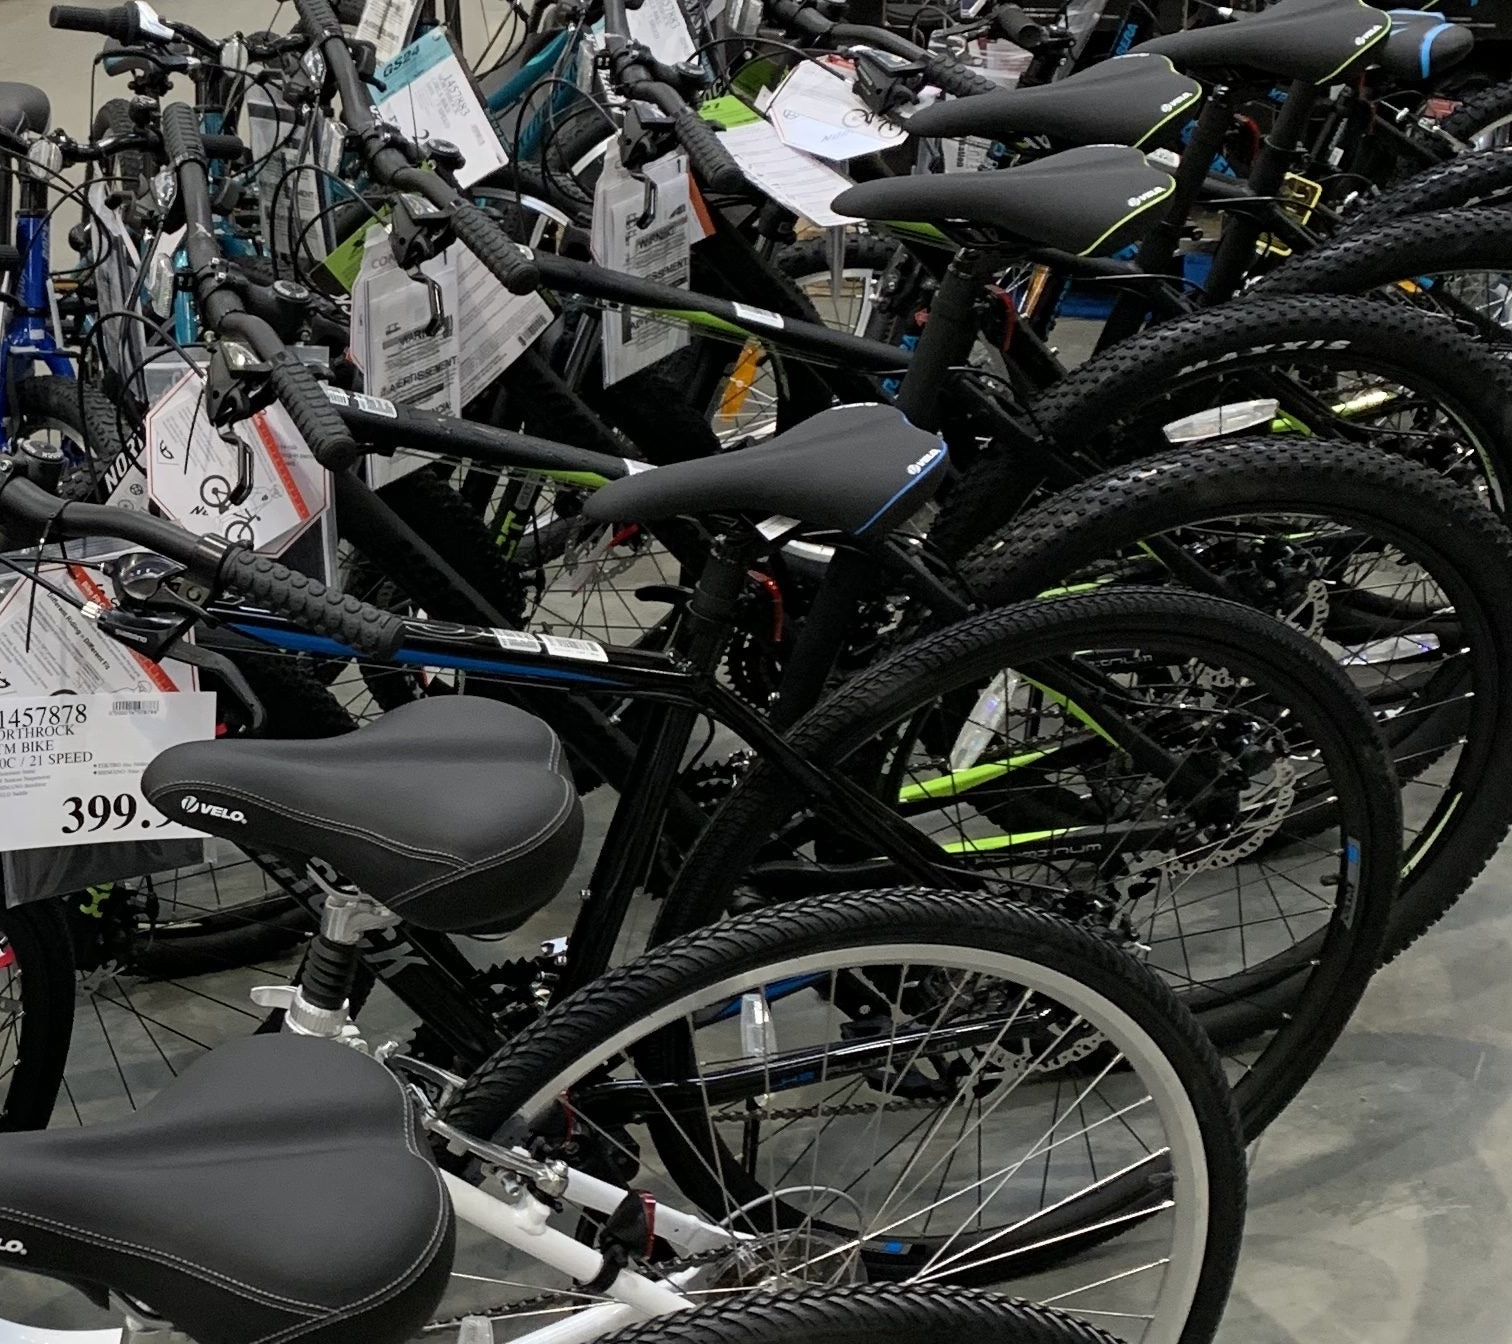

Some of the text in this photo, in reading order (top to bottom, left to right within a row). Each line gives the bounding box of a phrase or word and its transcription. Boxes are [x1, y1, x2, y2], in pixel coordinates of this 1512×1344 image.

[62, 613, 81, 635] Riding
[81, 636, 105, 663] Different
[21, 740, 54, 754] BIKE
[29, 755, 43, 768] 21
[48, 751, 94, 766] SPEED
[61, 793, 174, 834] 399.
[200, 802, 245, 823] VELO
